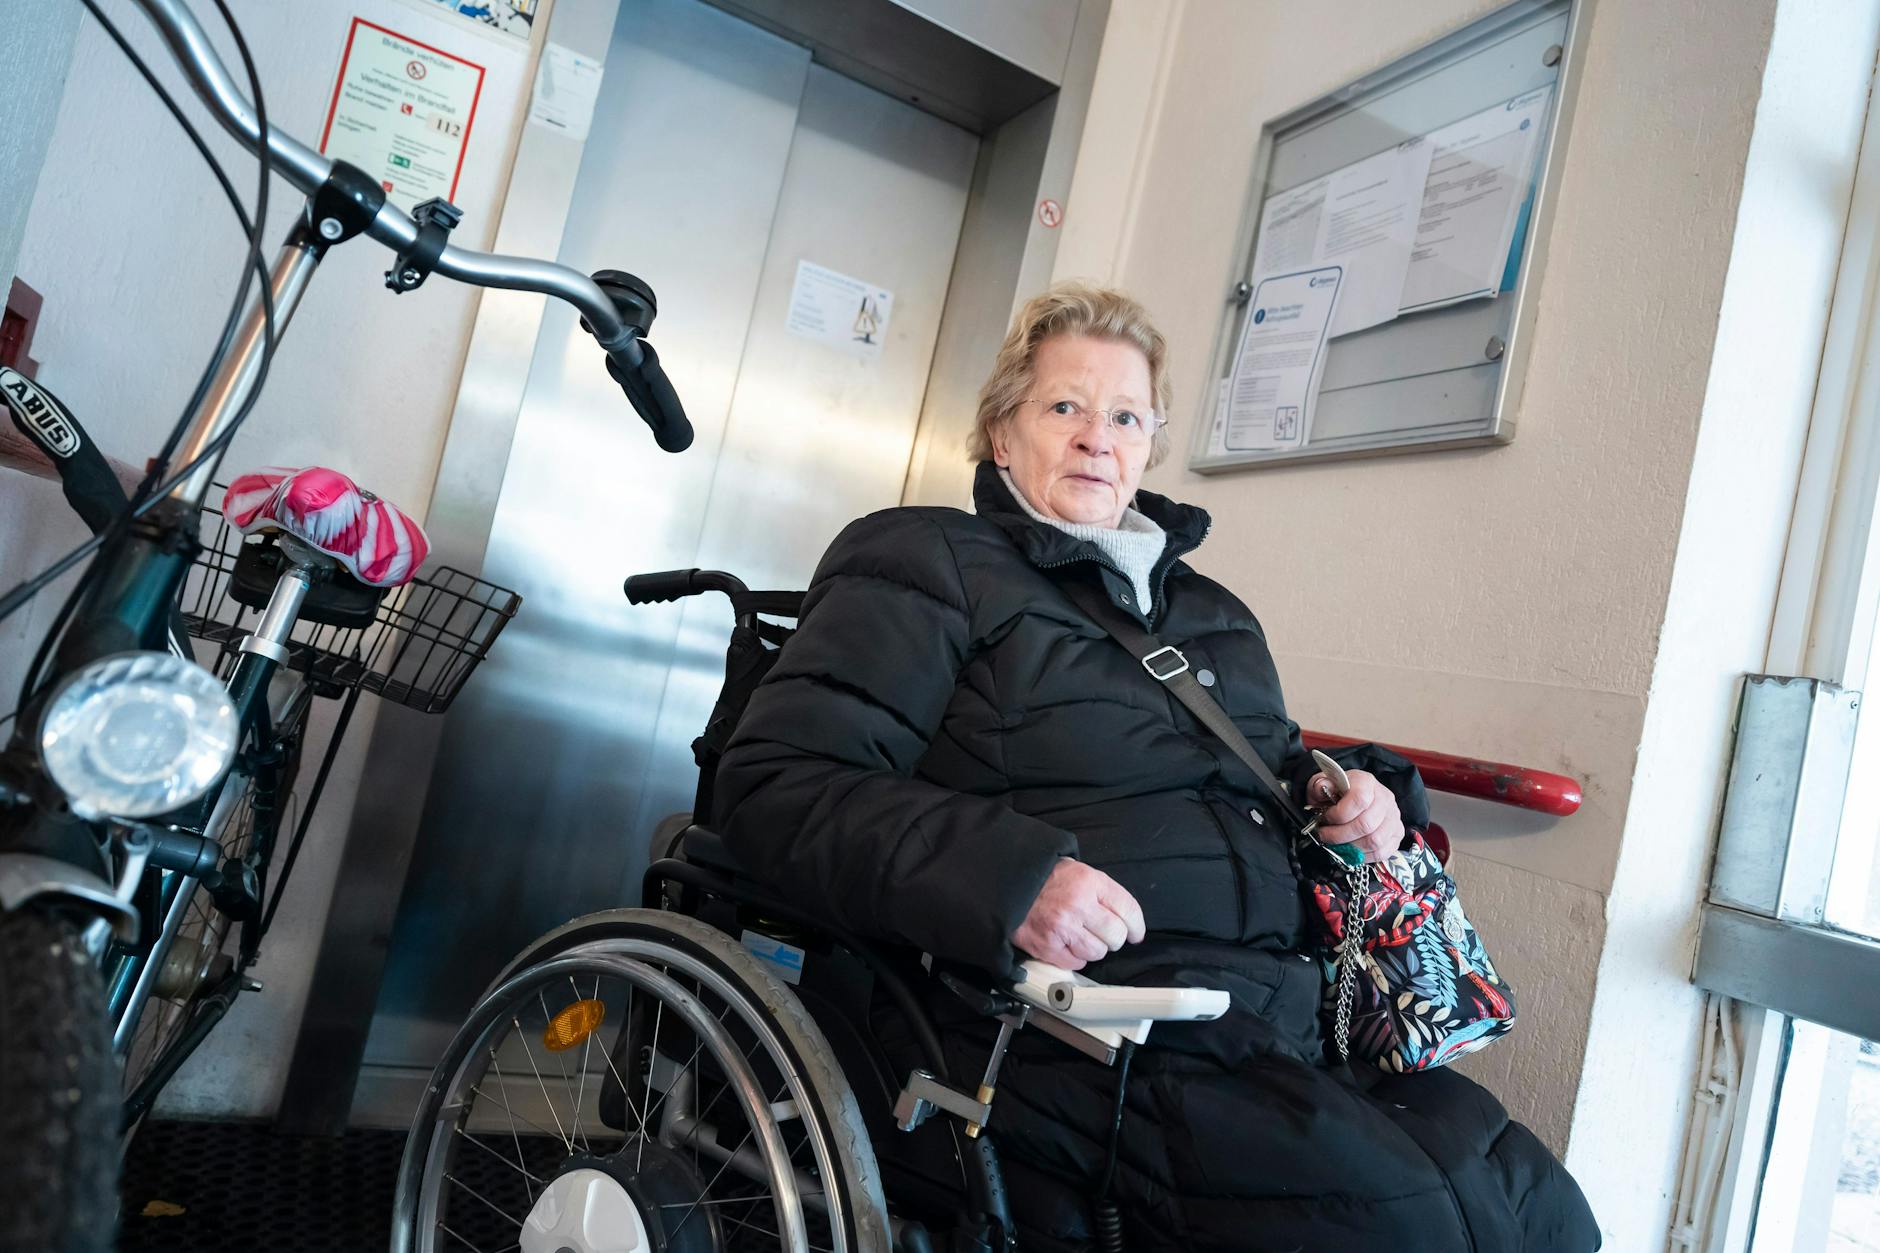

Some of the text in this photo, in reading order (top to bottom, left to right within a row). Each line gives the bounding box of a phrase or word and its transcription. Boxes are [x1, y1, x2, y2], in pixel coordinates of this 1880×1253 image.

[382, 37, 415, 55] Brände
[360, 72, 402, 94] Verhalten
[436, 118, 460, 137] 112
[5, 379, 70, 445] ABUS
